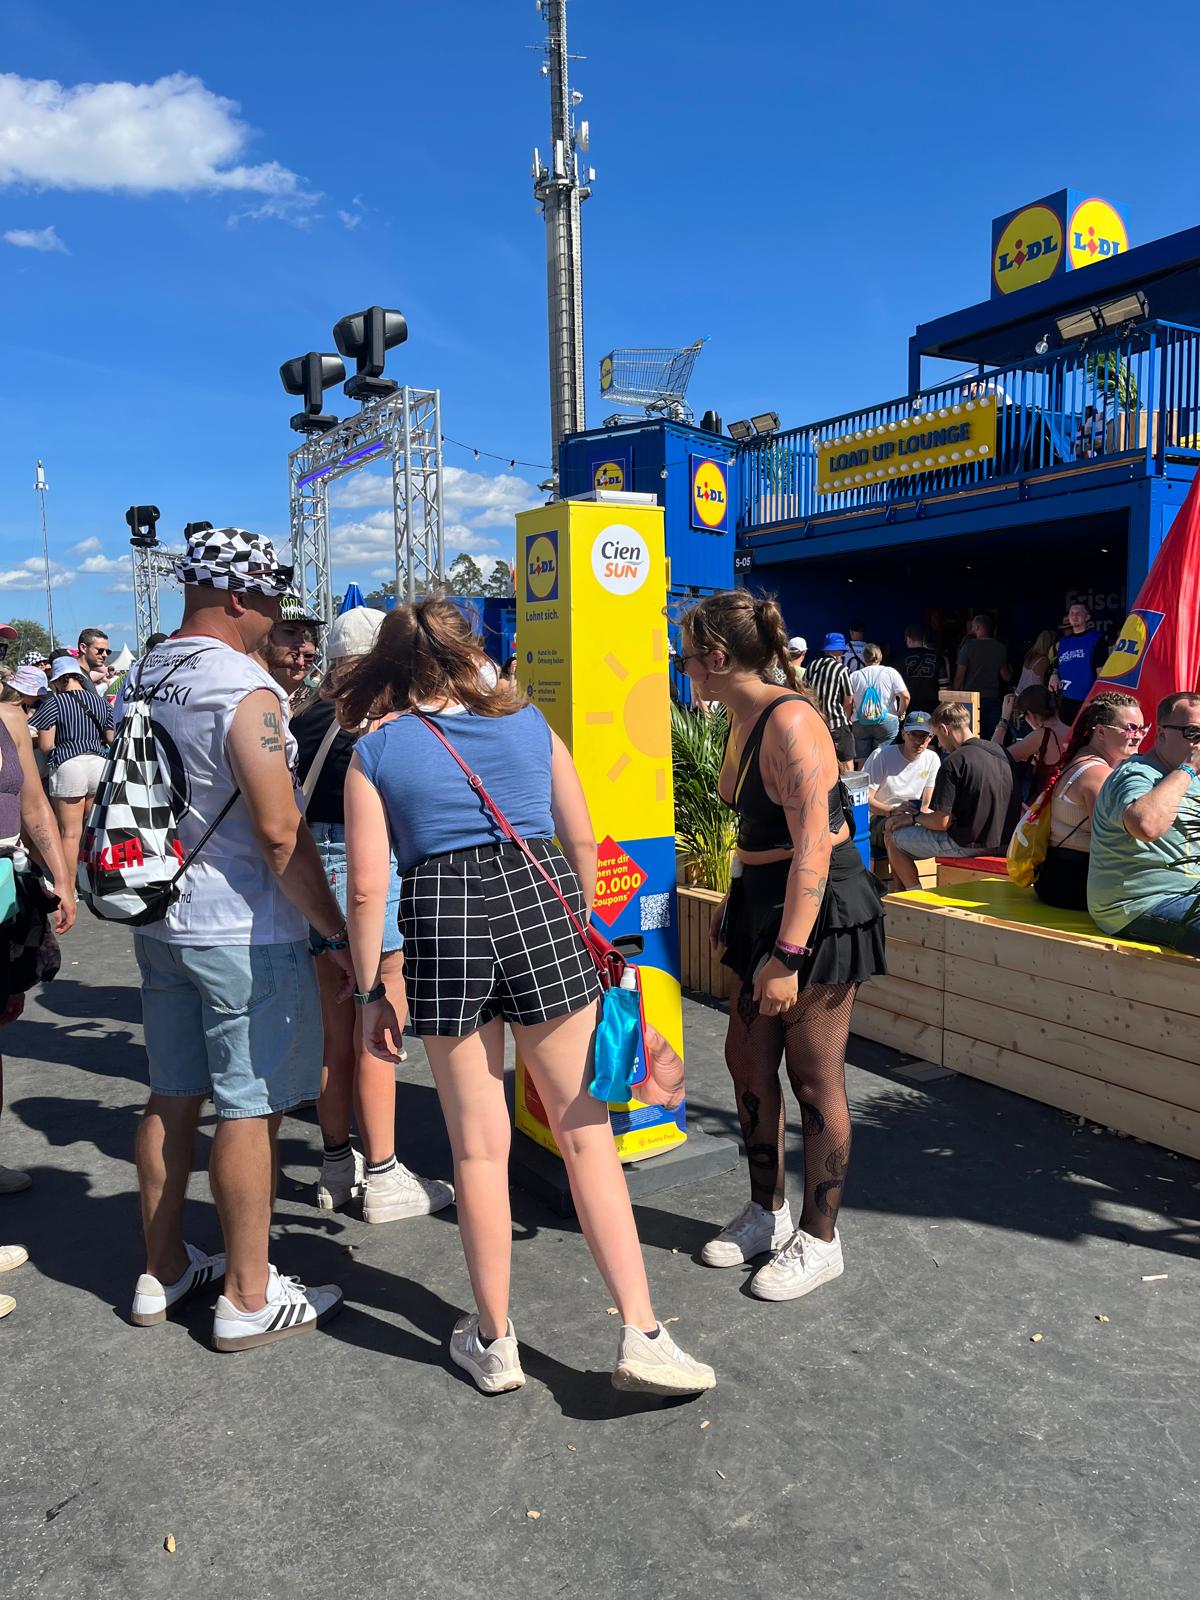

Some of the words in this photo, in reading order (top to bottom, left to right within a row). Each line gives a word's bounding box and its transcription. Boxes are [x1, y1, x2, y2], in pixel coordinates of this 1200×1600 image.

[829, 448, 869, 473] LOAD
[872, 440, 895, 462] UP
[898, 422, 971, 456] LOUNGE
[601, 541, 641, 561] Cien
[604, 562, 638, 578] SUN
[525, 610, 543, 622] Lohnt
[544, 609, 559, 621] sich.
[1115, 638, 1139, 655] DL
[597, 857, 616, 868] here
[617, 854, 630, 864] dir
[596, 868, 611, 878] nen
[613, 866, 628, 875] von
[595, 873, 641, 896] 0.000
